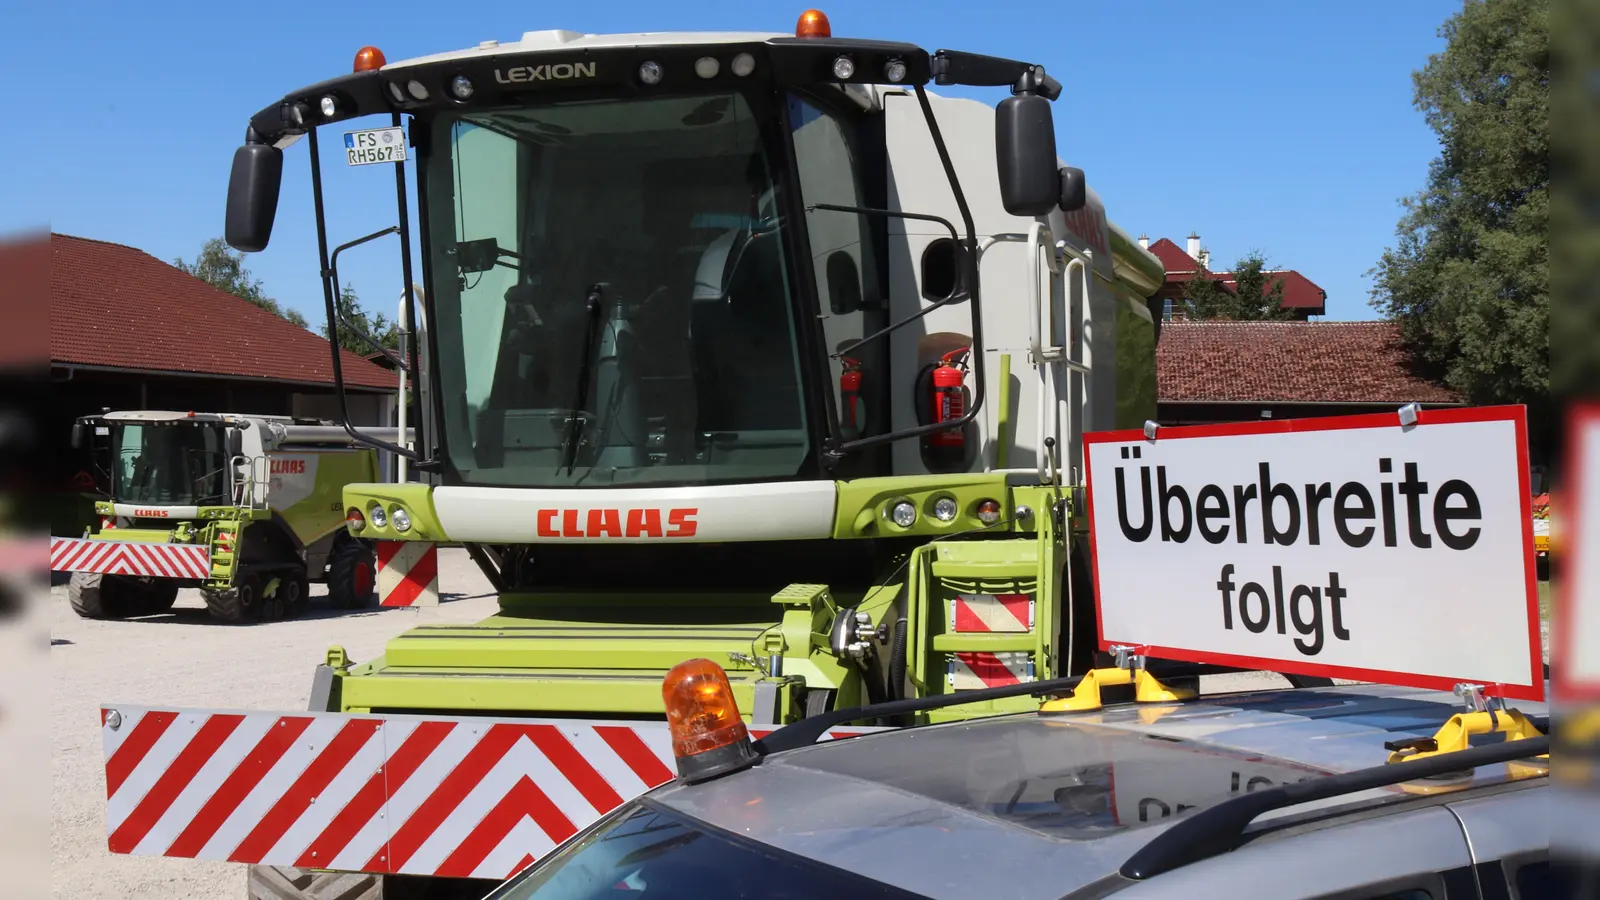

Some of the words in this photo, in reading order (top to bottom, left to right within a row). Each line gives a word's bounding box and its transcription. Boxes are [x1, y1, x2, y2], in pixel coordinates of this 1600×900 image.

[494, 62, 596, 84] LEXION
[357, 133, 377, 147] FS
[348, 146, 393, 164] RH567
[270, 459, 305, 474] CLAAS
[1115, 446, 1482, 551] Überbreite
[134, 509, 169, 518] CLAAS
[536, 508, 699, 538] CLAAS
[1216, 563, 1350, 656] folgt
